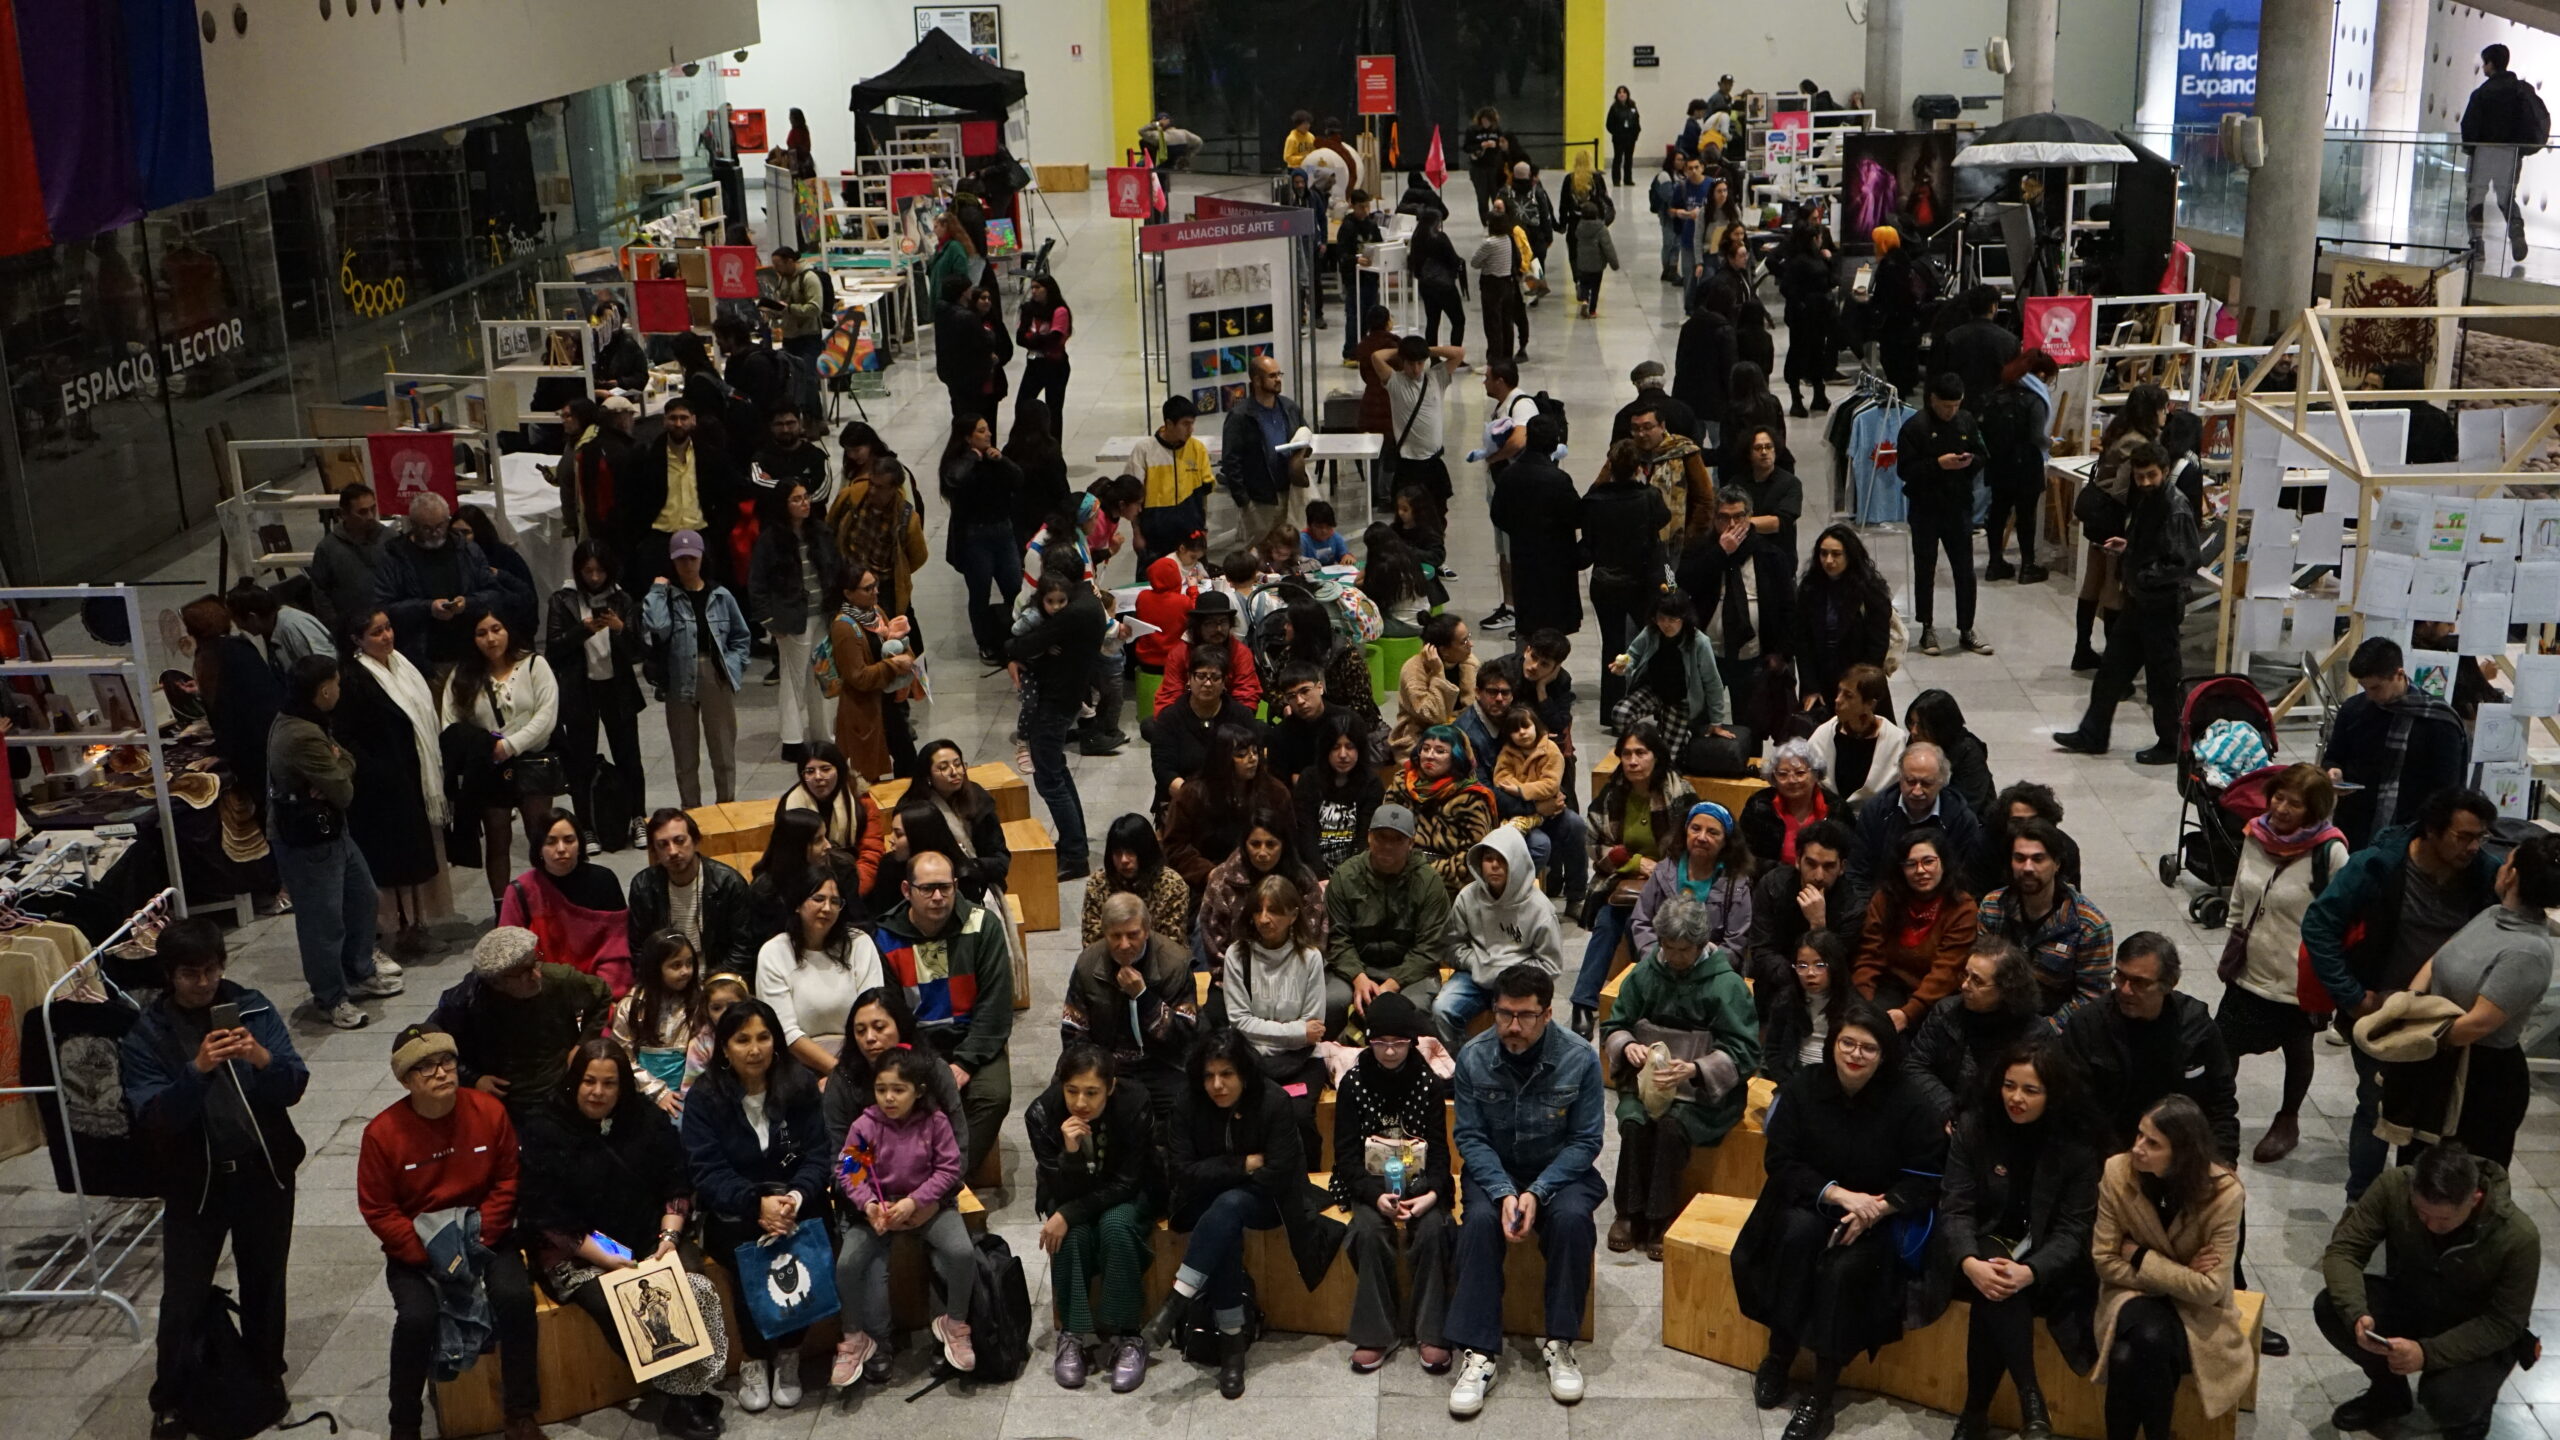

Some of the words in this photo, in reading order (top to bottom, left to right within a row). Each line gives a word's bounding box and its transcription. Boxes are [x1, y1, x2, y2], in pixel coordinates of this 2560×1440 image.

[2201, 50, 2258, 71] Mirad
[2181, 75, 2257, 98] Expand
[1177, 224, 1229, 241] ALMACEN
[1231, 223, 1245, 235] DE
[1247, 221, 1275, 233] ARTE
[62, 353, 156, 416] ESPACIO
[168, 318, 245, 373] LECTOR
